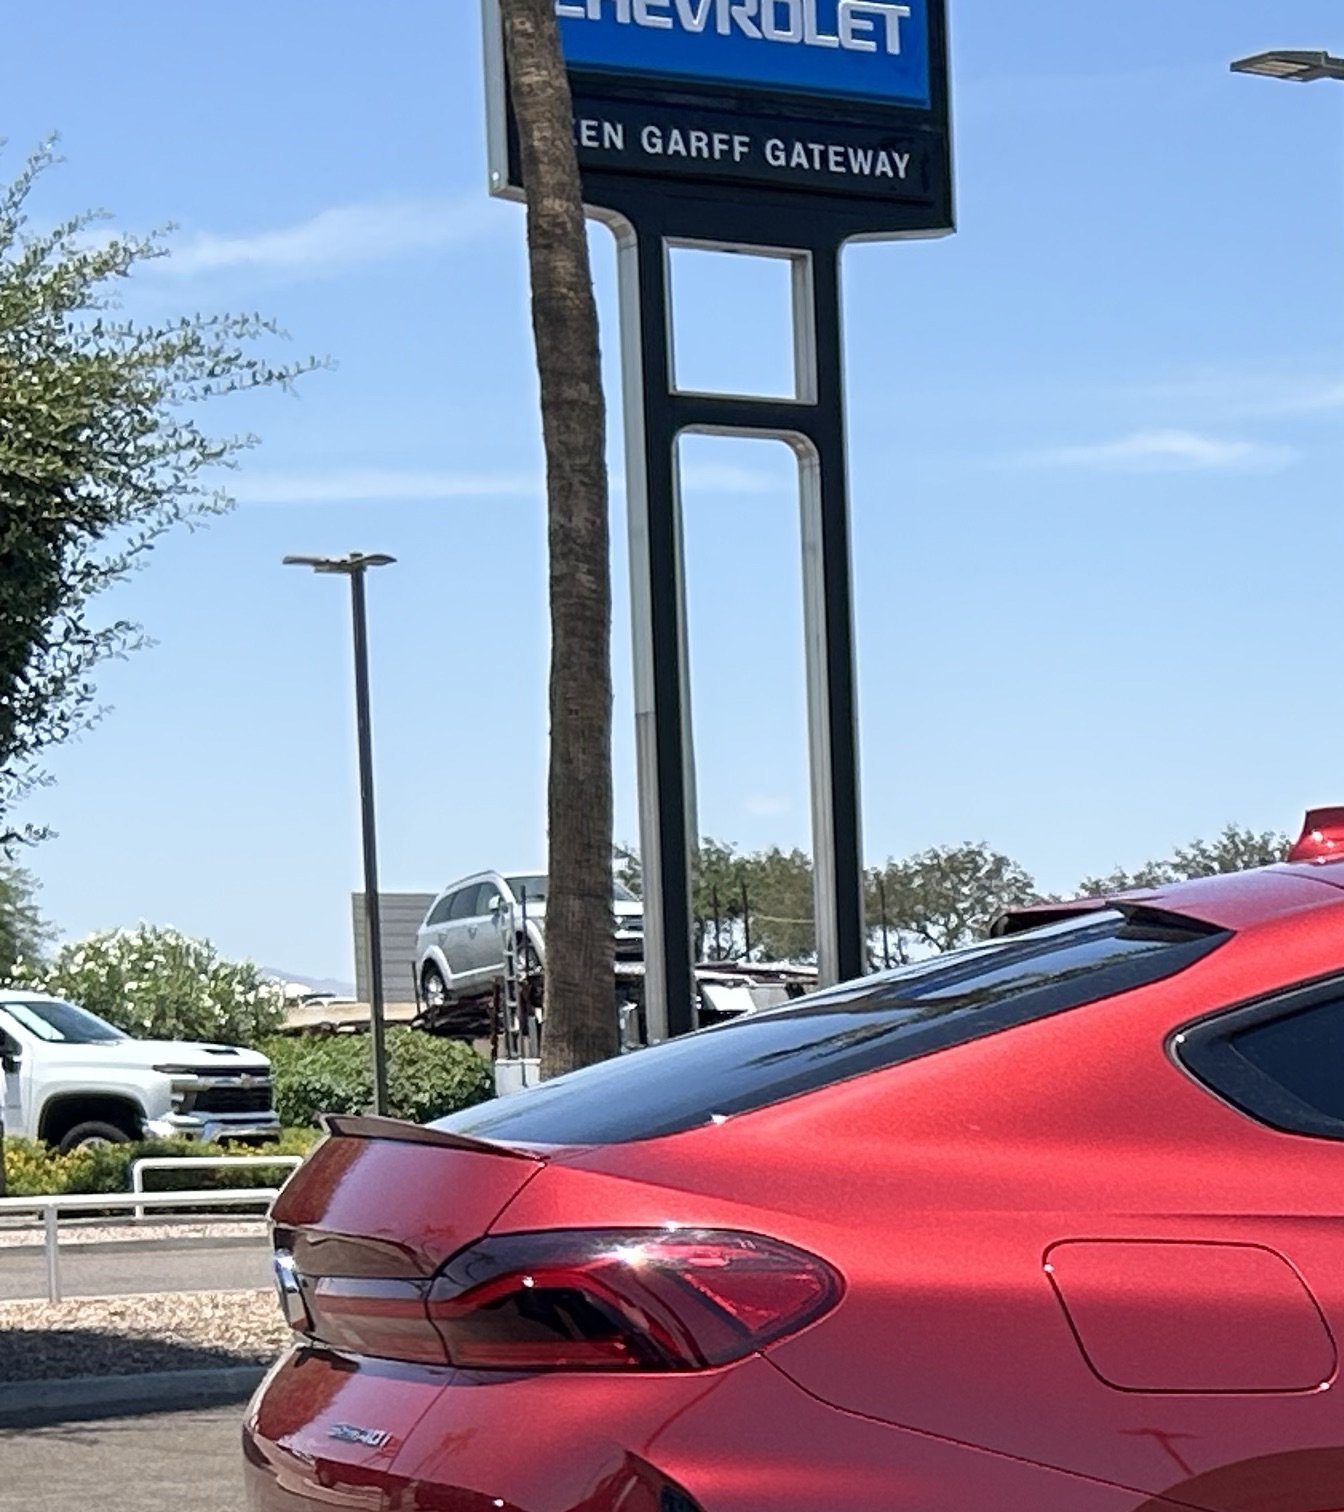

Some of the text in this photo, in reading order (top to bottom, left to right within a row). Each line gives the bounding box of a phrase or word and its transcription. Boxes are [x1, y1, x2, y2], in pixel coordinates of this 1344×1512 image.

[572, 118, 911, 179] EN GARFF GATEWAY
